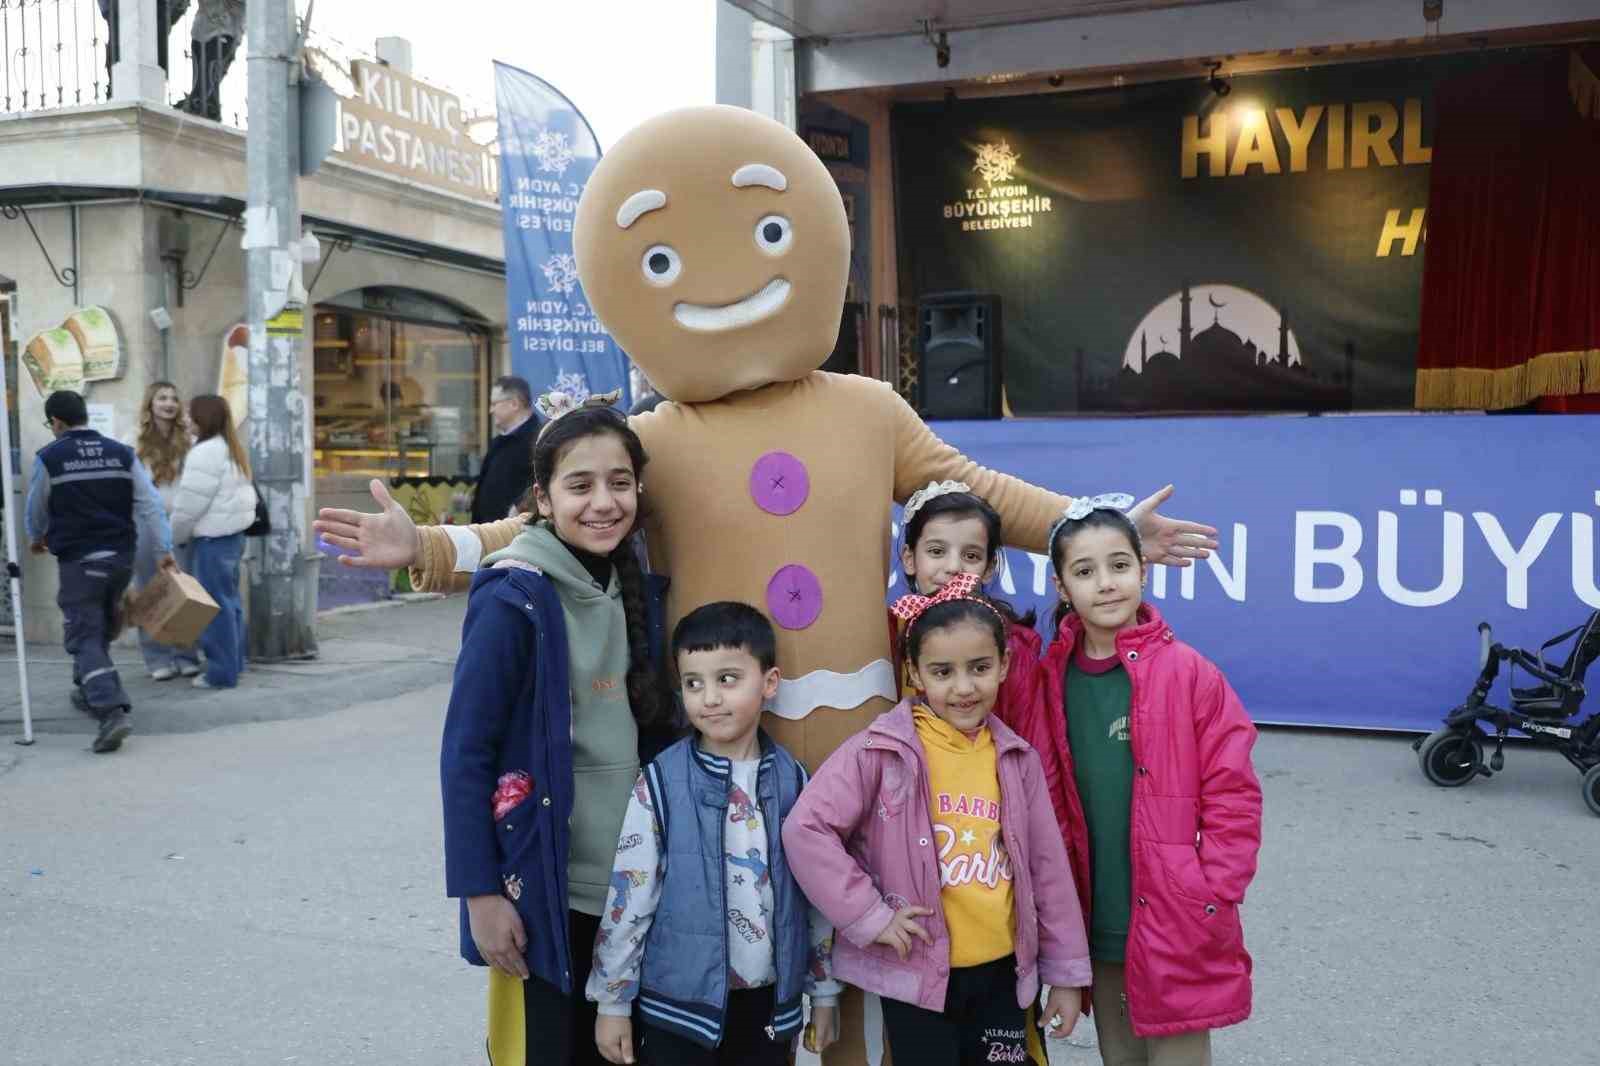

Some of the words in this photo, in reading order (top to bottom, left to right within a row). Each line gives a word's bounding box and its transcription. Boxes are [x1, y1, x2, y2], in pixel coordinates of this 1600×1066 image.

[361, 67, 459, 145] KILINÇ
[966, 188, 988, 200] T.C.
[990, 184, 1028, 199] AYDIN
[944, 195, 1052, 218] BÜYÜKŞEHİR
[962, 215, 1032, 232] BELEDİYESİ
[1376, 207, 1427, 257] H
